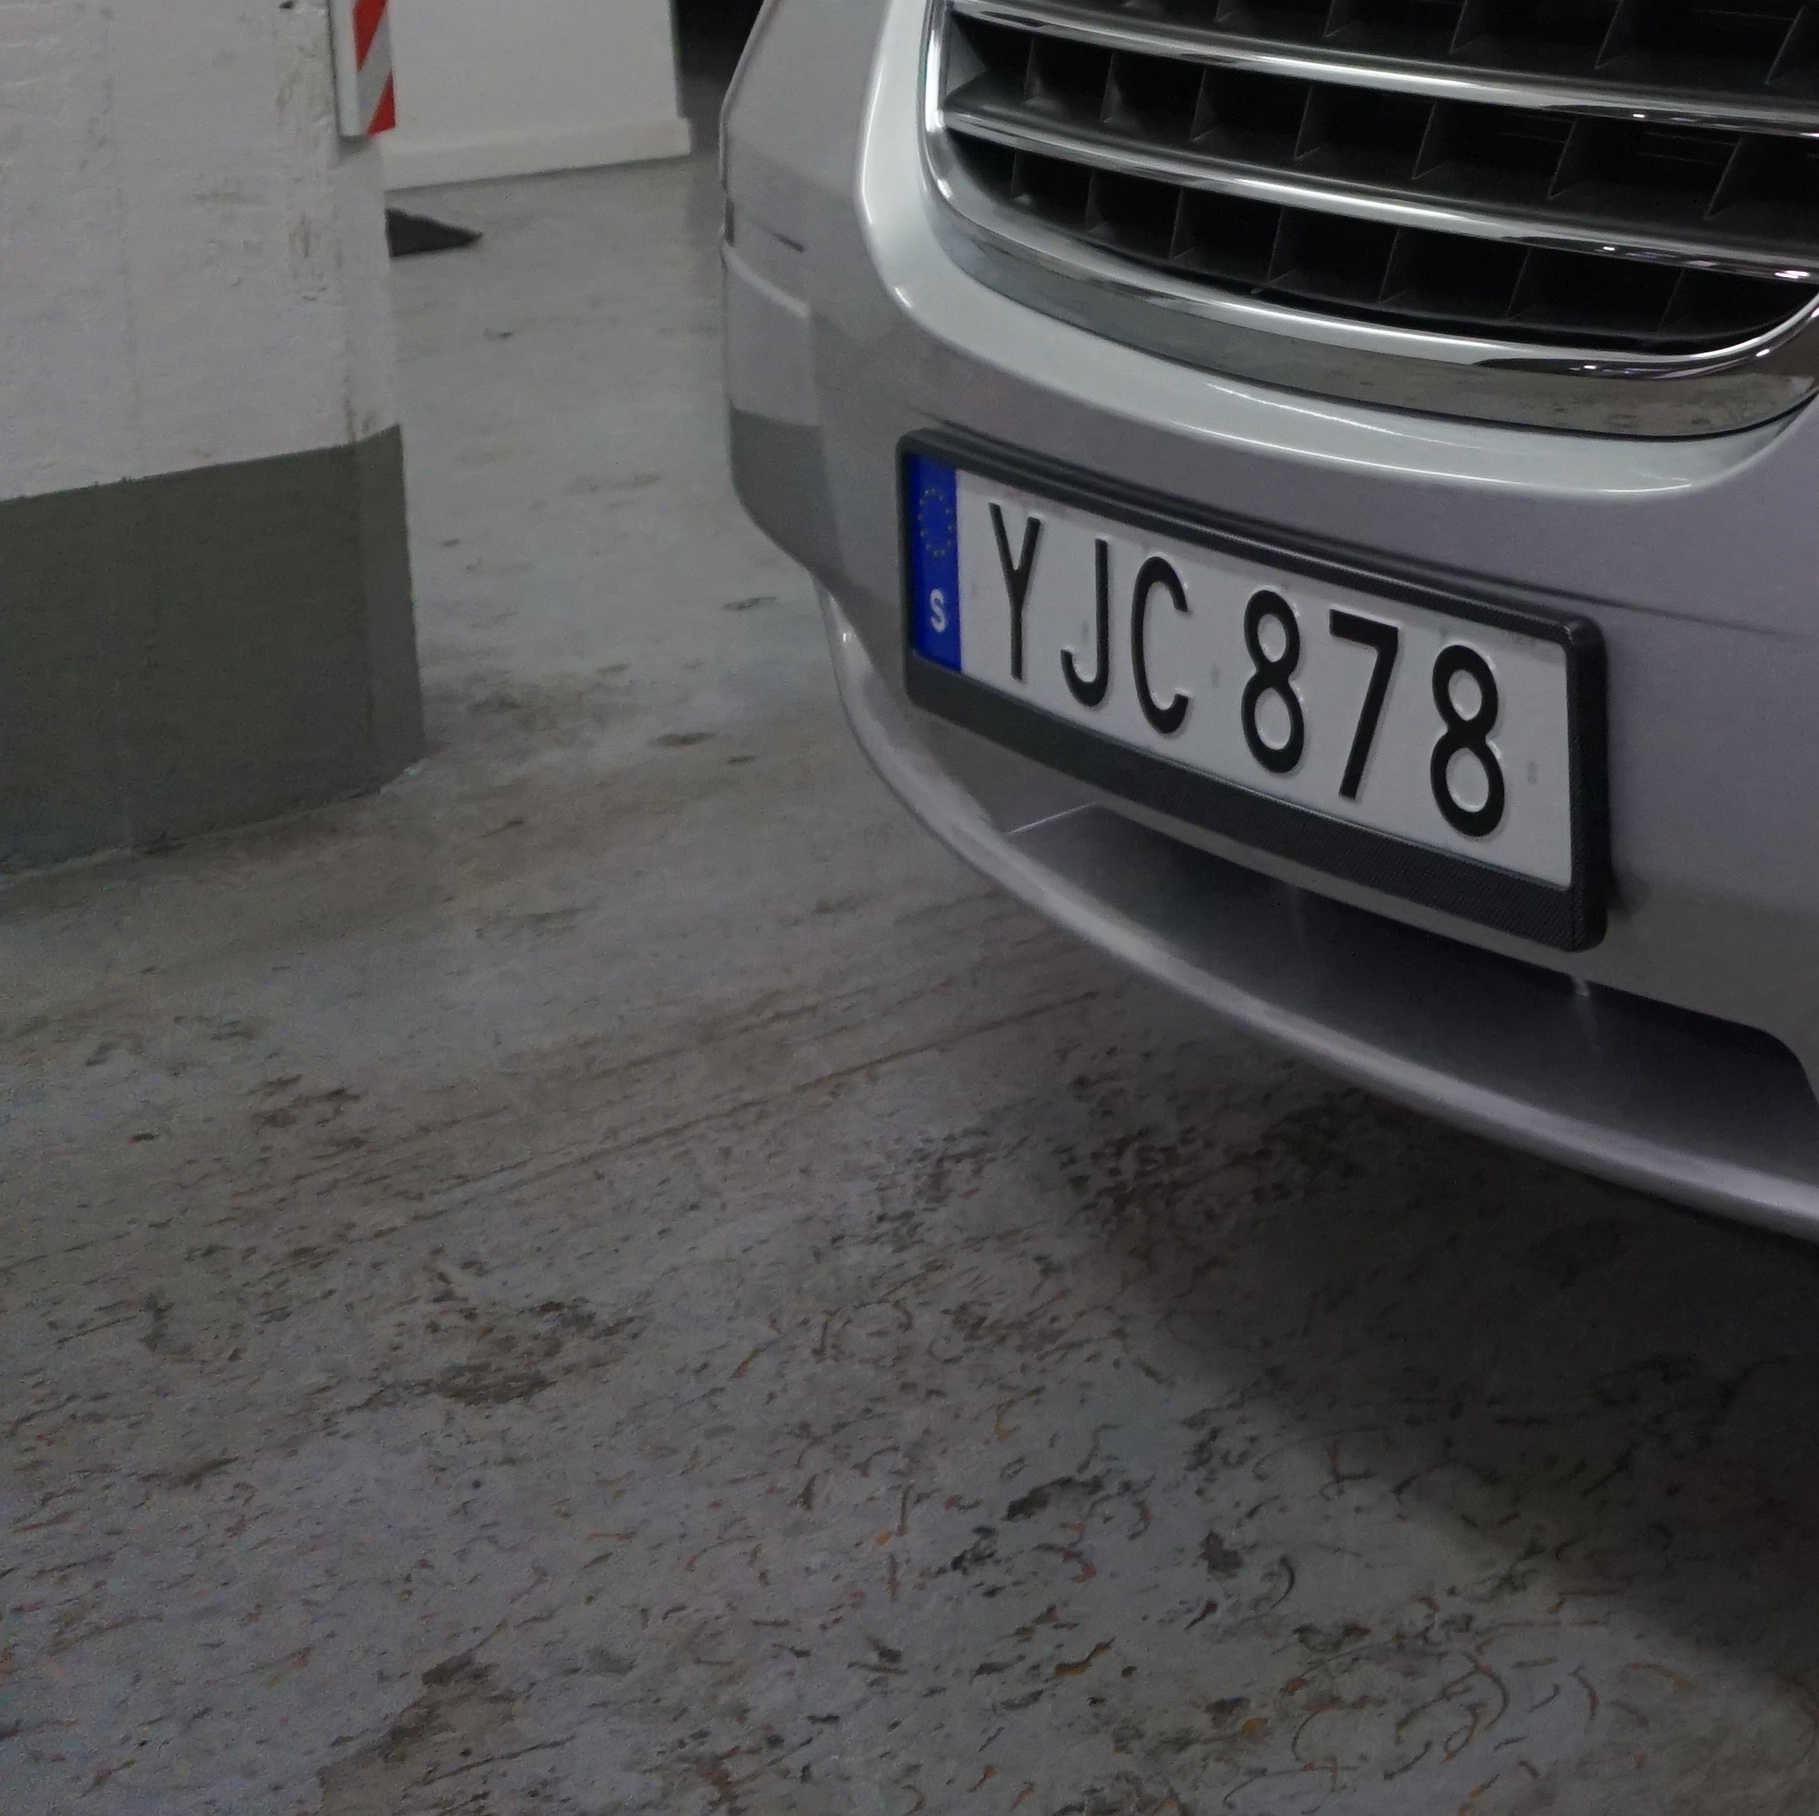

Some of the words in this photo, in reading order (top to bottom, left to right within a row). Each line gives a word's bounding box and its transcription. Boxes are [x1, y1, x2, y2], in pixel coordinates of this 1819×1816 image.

[930, 589, 948, 634] S
[989, 502, 1190, 734] YJC
[1241, 589, 1506, 837] 878
